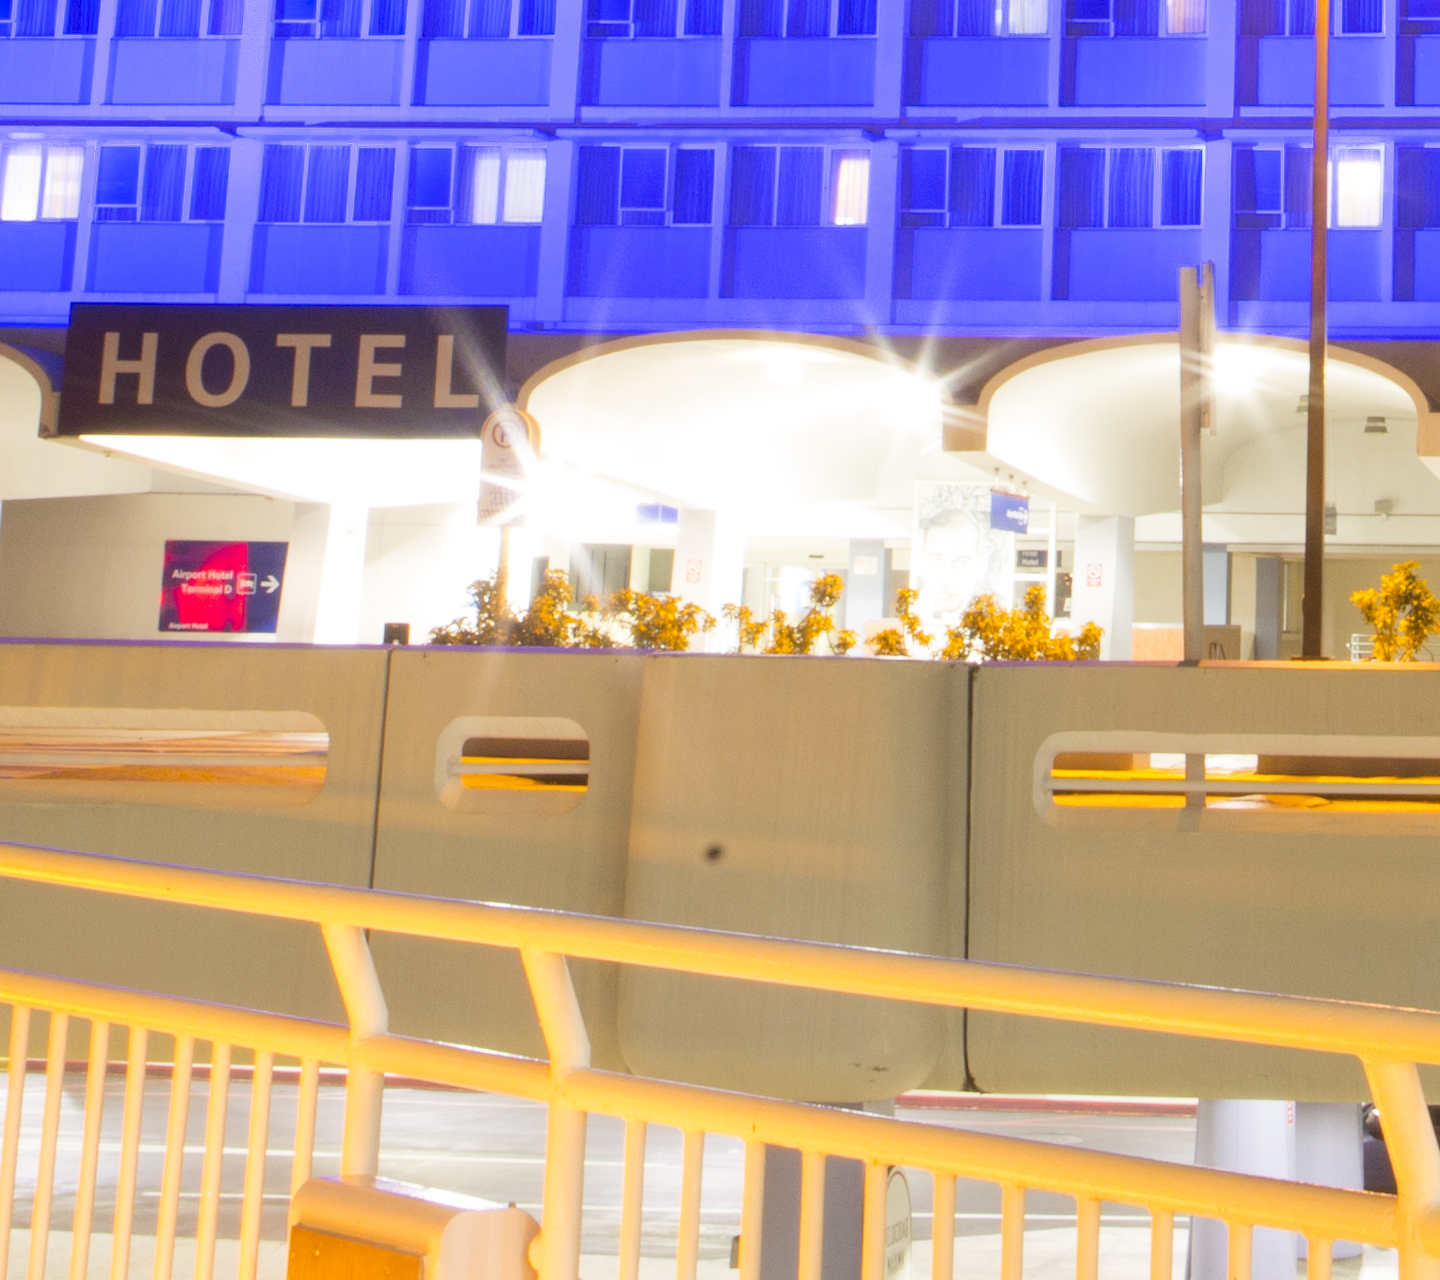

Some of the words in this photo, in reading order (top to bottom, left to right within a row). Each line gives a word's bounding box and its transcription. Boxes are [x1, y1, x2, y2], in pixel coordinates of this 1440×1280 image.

[98, 331, 480, 409] HOTEL
[172, 569, 206, 581] Airport
[208, 570, 233, 580] Hotel
[181, 584, 222, 594] Terminal
[224, 585, 233, 594] D
